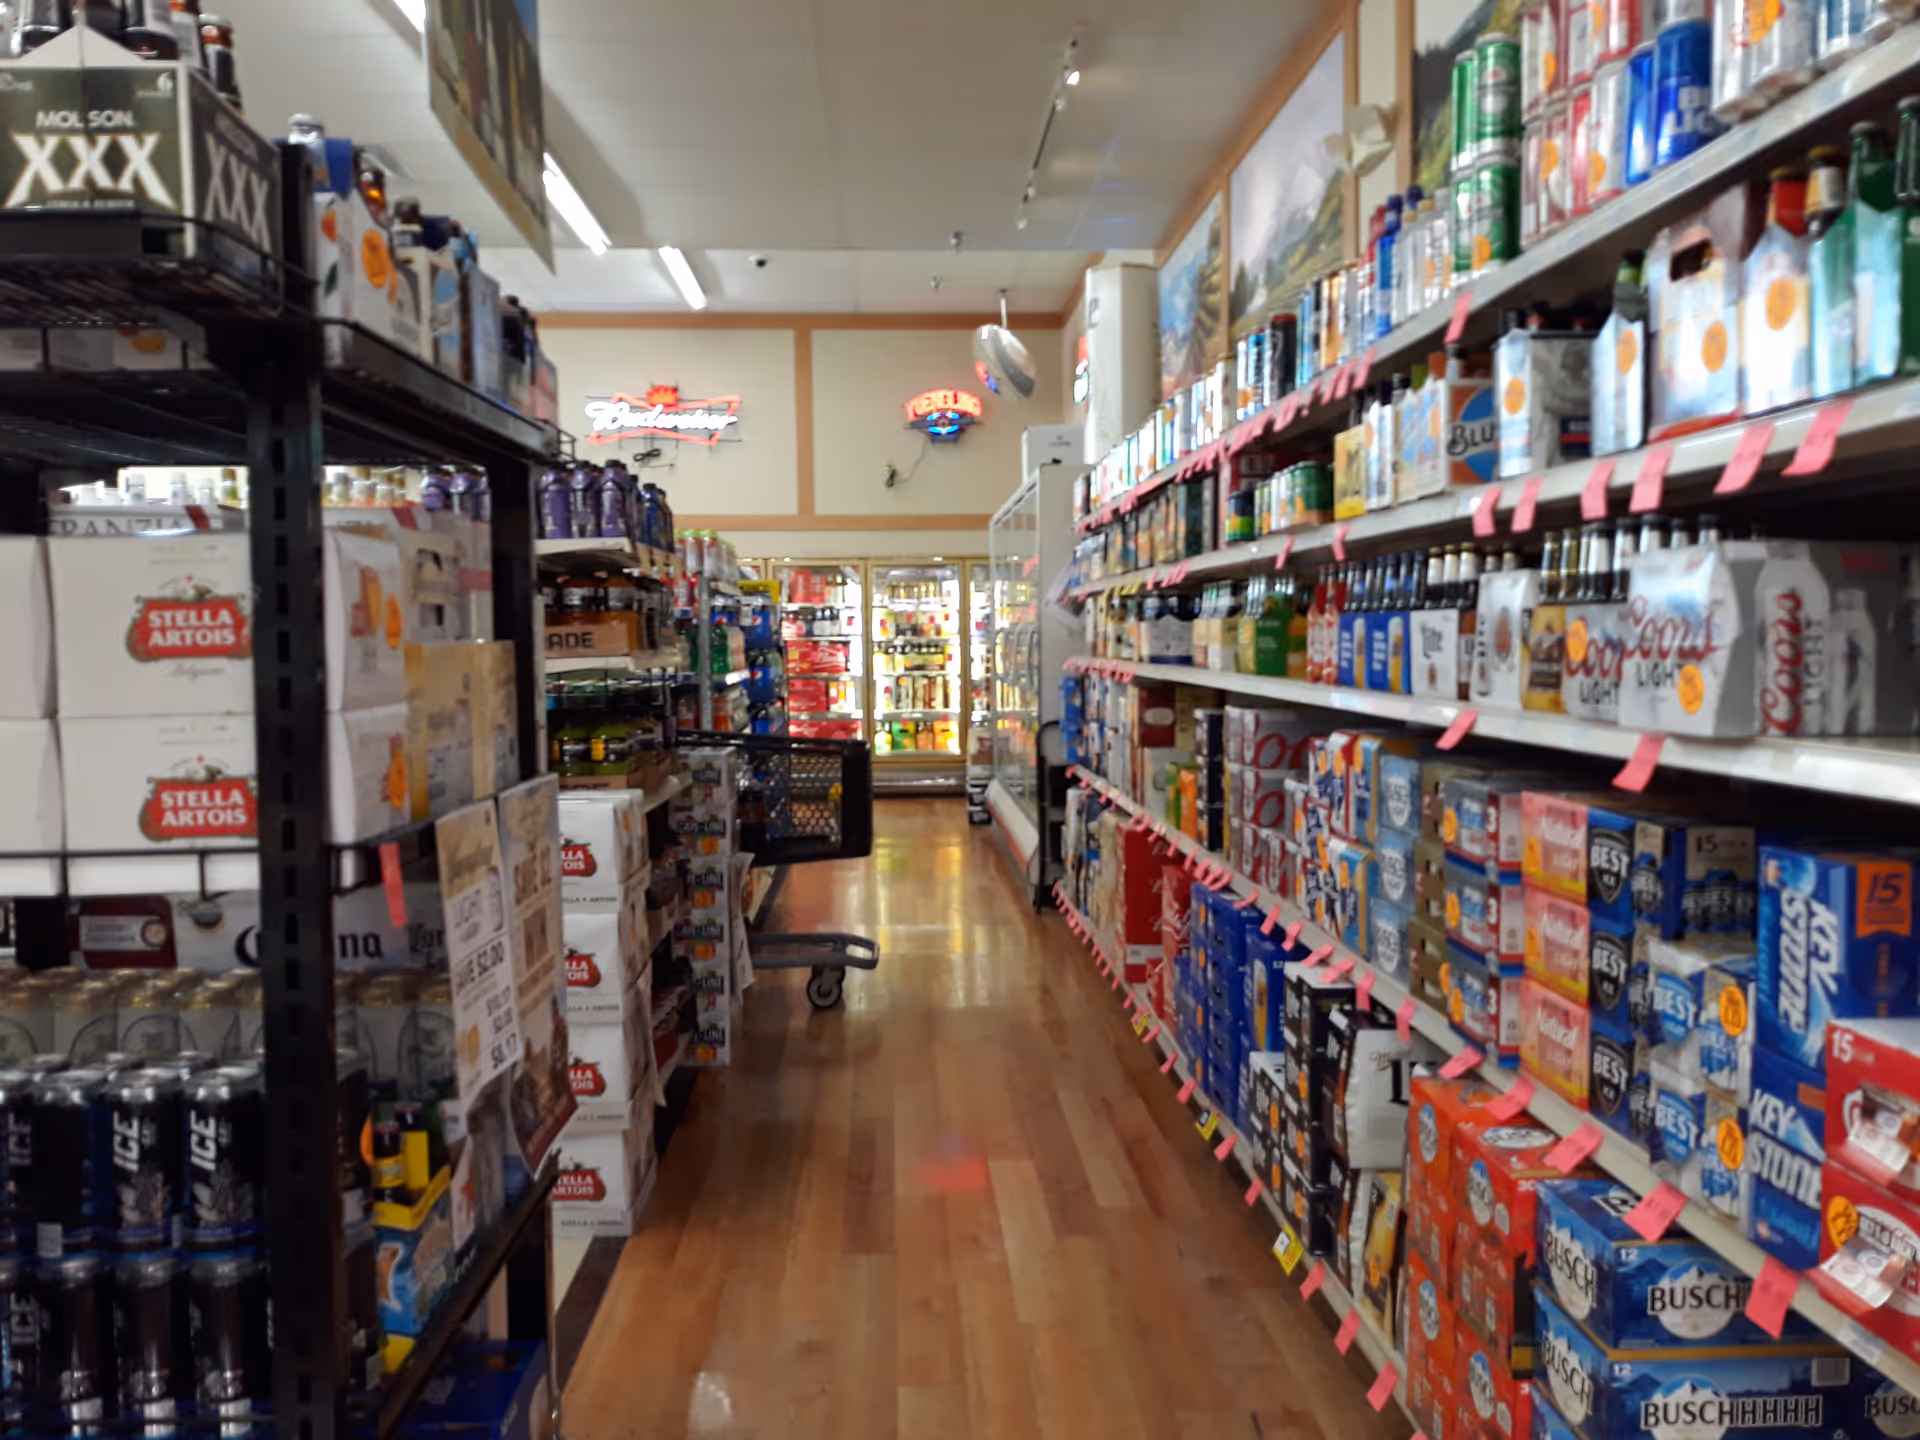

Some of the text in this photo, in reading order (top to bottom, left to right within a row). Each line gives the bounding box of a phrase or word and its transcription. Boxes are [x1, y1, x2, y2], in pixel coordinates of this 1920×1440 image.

[5, 132, 177, 209] XXX
[204, 131, 270, 255] XXX
[584, 401, 738, 431] Budweiser
[904, 389, 982, 421] YUENGLING
[149, 608, 234, 627] STELLA
[149, 628, 235, 646] ARTOIS
[161, 788, 245, 808] STELLA
[161, 808, 247, 826] ARTOIS
[561, 850, 584, 860] LLA
[564, 861, 585, 870] OIS
[1591, 848, 1629, 879] BEST
[1866, 872, 1904, 903] 15
[1780, 888, 1807, 1034] STONE
[1811, 899, 1839, 994] KEY
[565, 961, 588, 970] LLA
[568, 971, 589, 980] OIS
[1592, 947, 1627, 984] BEST
[1653, 986, 1695, 1028] BEST
[1832, 1030, 1854, 1062] 15
[1593, 1051, 1628, 1092] BEST
[1655, 1102, 1698, 1148] BEST
[1752, 1088, 1796, 1139] KEY
[113, 1110, 139, 1172] ICE
[190, 1110, 217, 1171] ICE
[1545, 1228, 1595, 1299] BUSCH
[1620, 1249, 1638, 1261] 12
[1543, 1334, 1592, 1404] BUSCH
[1613, 1364, 1632, 1376] 12
[1866, 1397, 1920, 1418] BUSC
